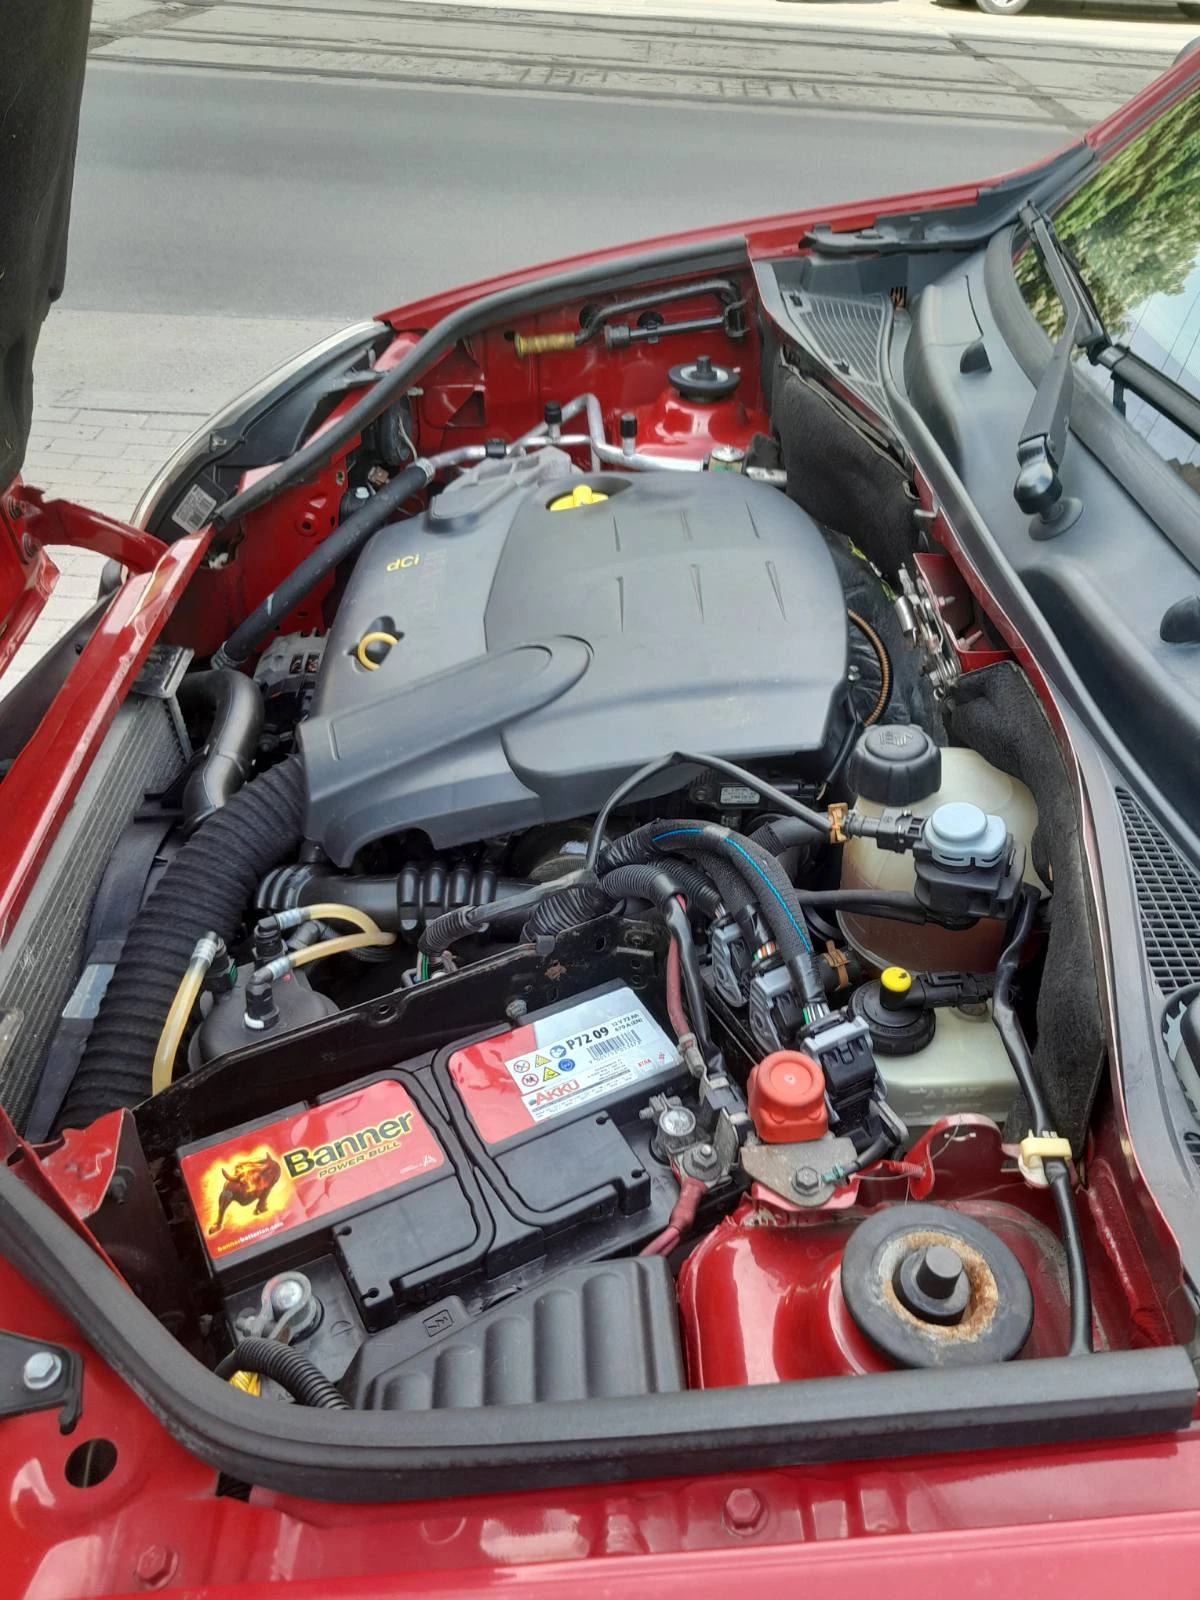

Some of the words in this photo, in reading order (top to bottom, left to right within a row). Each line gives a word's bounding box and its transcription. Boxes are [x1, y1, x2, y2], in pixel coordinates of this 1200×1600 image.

[386, 553, 420, 572] dCi
[566, 1033, 593, 1050] P72
[592, 1026, 609, 1040] 09
[535, 1079, 580, 1105] AKKU
[283, 1111, 413, 1178] Banner
[319, 1154, 365, 1178] POWER
[368, 1141, 401, 1158] BULL
